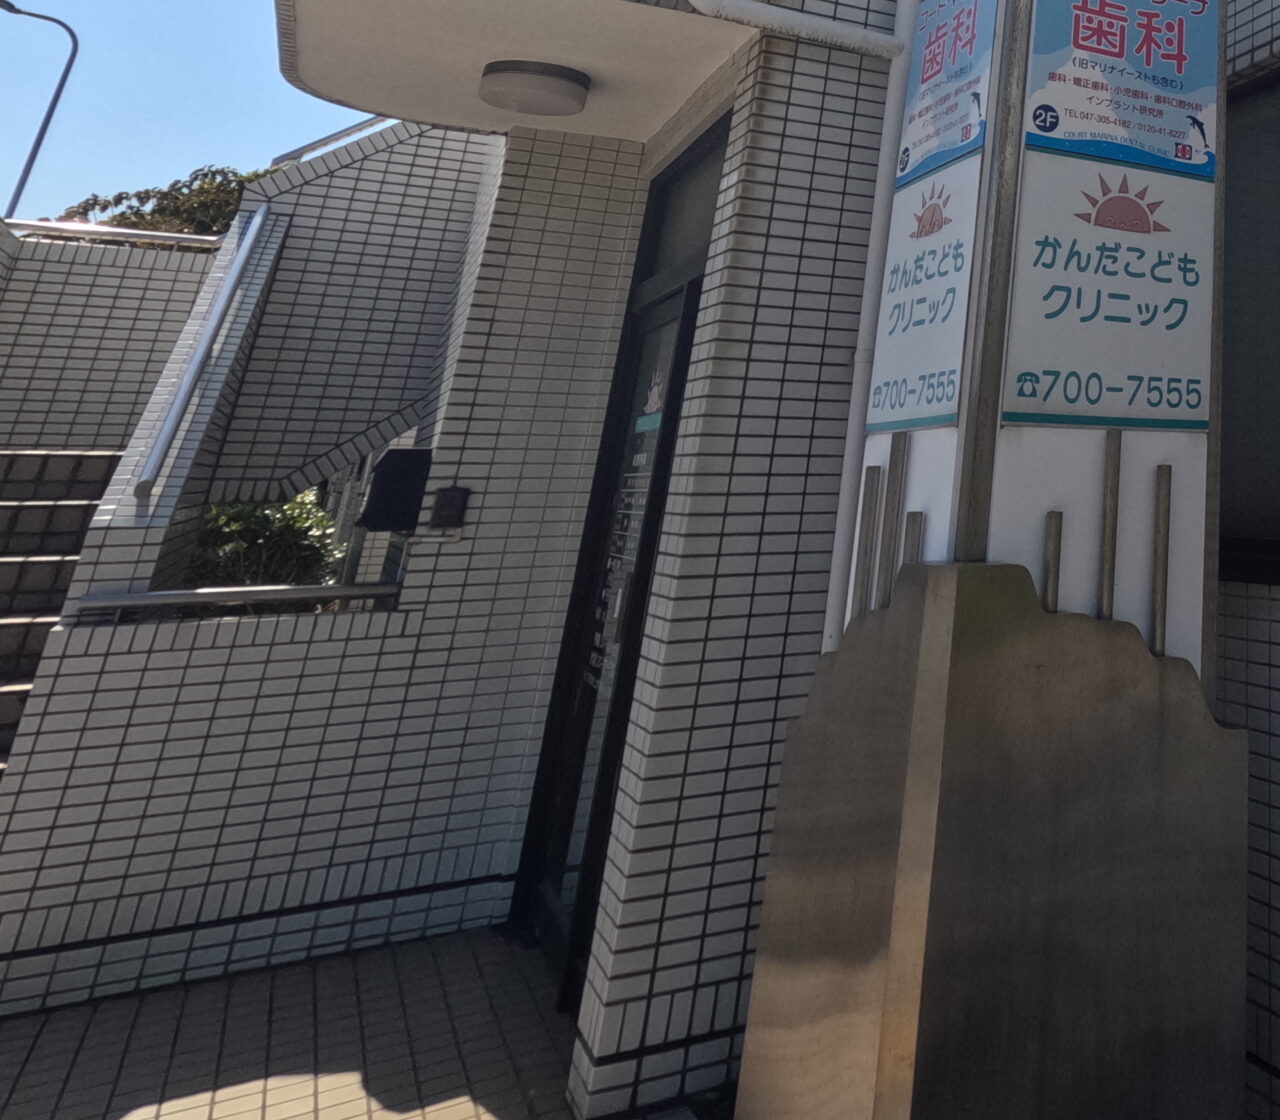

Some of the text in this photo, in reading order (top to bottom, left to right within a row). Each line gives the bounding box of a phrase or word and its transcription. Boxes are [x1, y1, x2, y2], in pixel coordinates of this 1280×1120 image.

[1034, 109, 1058, 128] 2F
[887, 238, 965, 295] かんだこども
[1033, 235, 1200, 286] かんだこども
[888, 286, 956, 336] クリニック
[1042, 284, 1188, 330] クリニック
[881, 368, 957, 411] 700-7555
[1042, 369, 1202, 409] 700-7555
